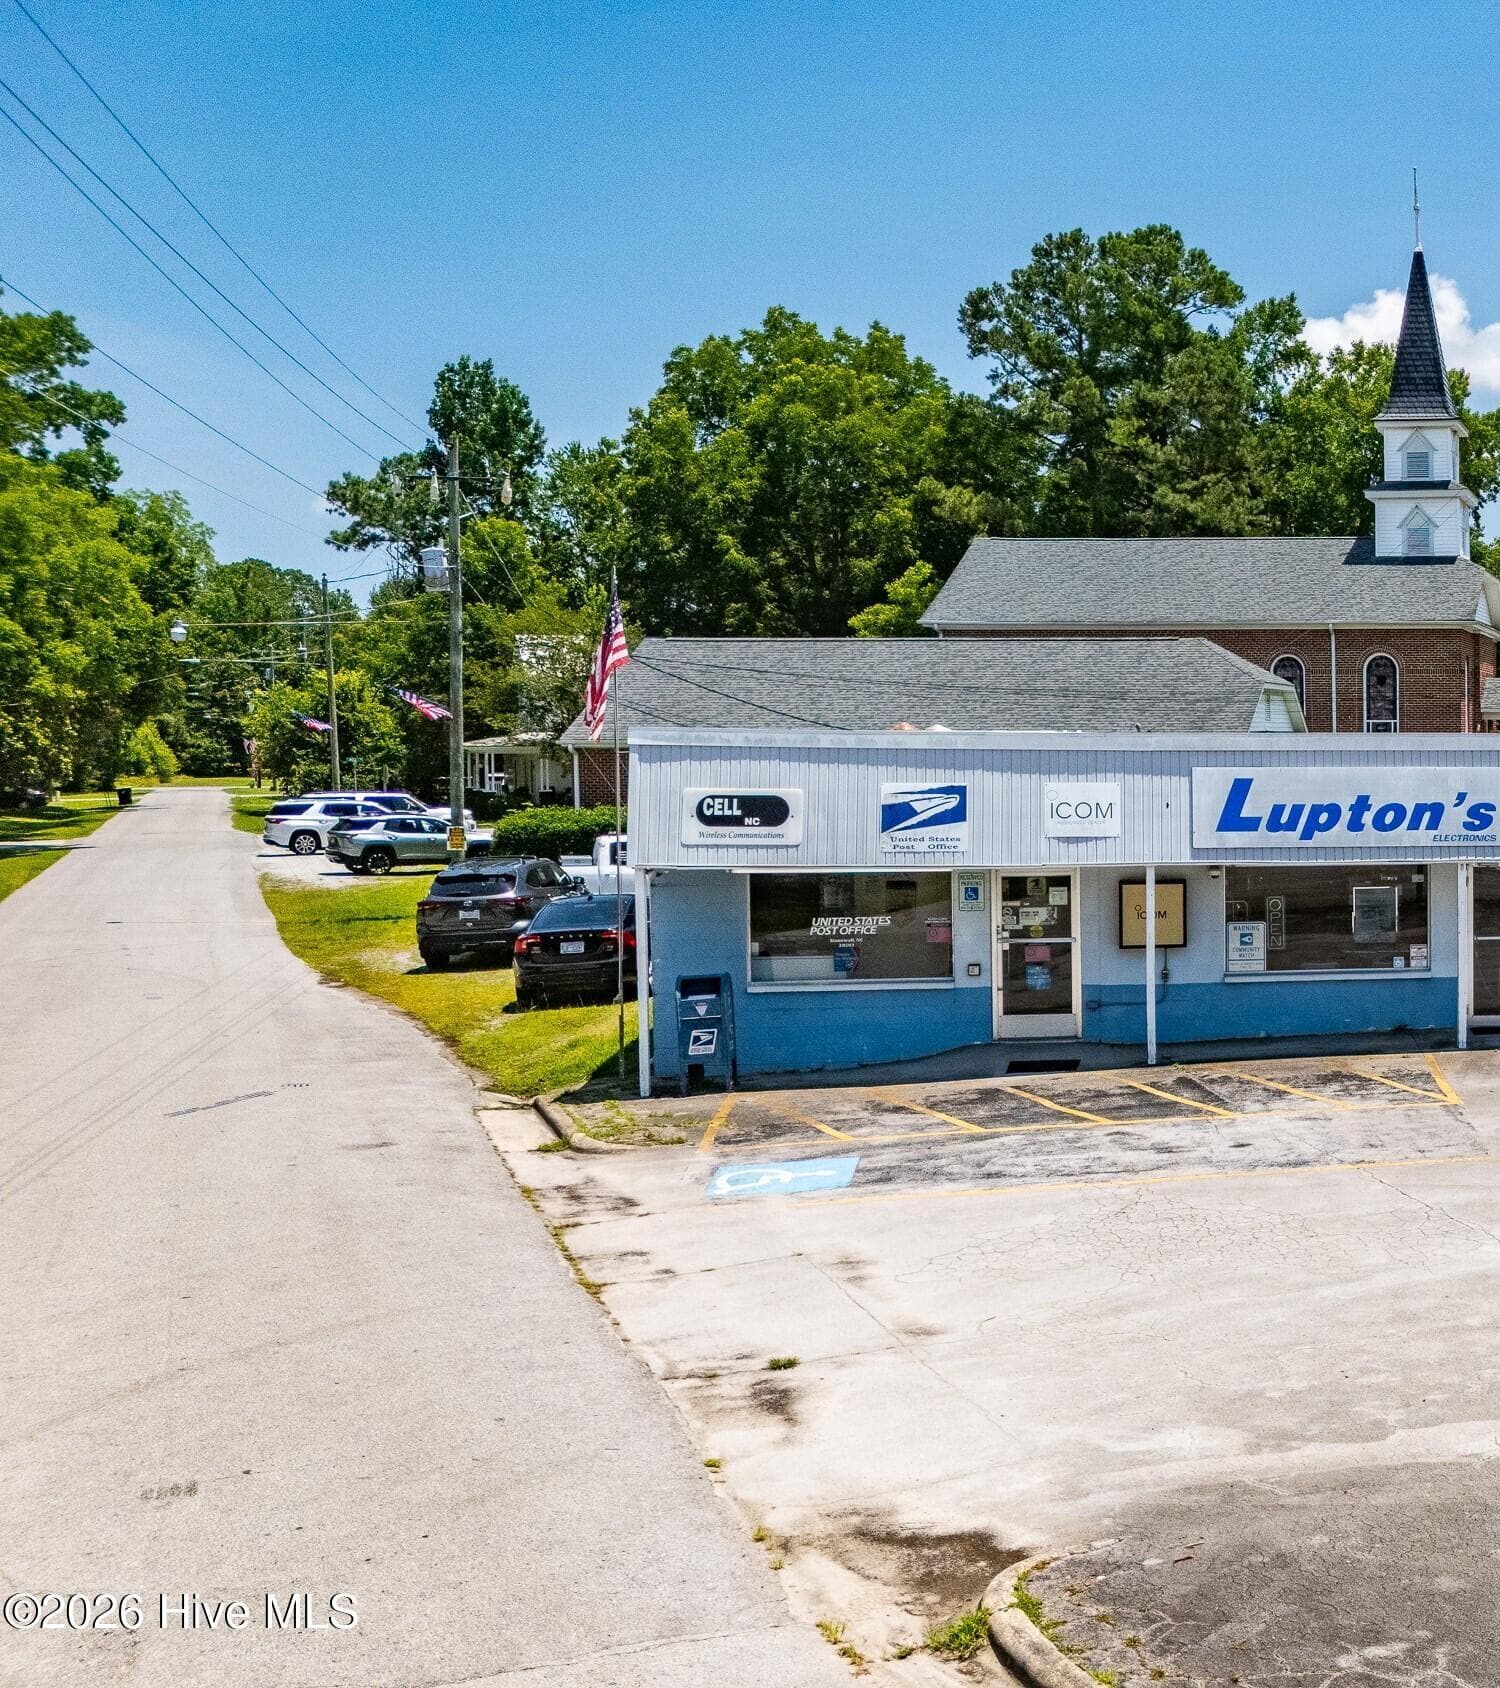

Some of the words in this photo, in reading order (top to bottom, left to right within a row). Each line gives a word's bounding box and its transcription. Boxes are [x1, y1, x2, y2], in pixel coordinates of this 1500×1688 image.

[703, 798, 742, 816] CELL
[1050, 801, 1113, 819] ICOM
[1216, 778, 1496, 841] Lupton's
[744, 817, 760, 826] NC
[699, 831, 727, 839] Wireless
[728, 831, 785, 839] Communications
[1433, 834, 1496, 842] ELECTRONICS
[1137, 911, 1167, 920] ICM
[812, 917, 853, 926] UNITED
[853, 916, 892, 926] STATES
[809, 926, 842, 936] POST
[843, 926, 878, 935] OFFICE
